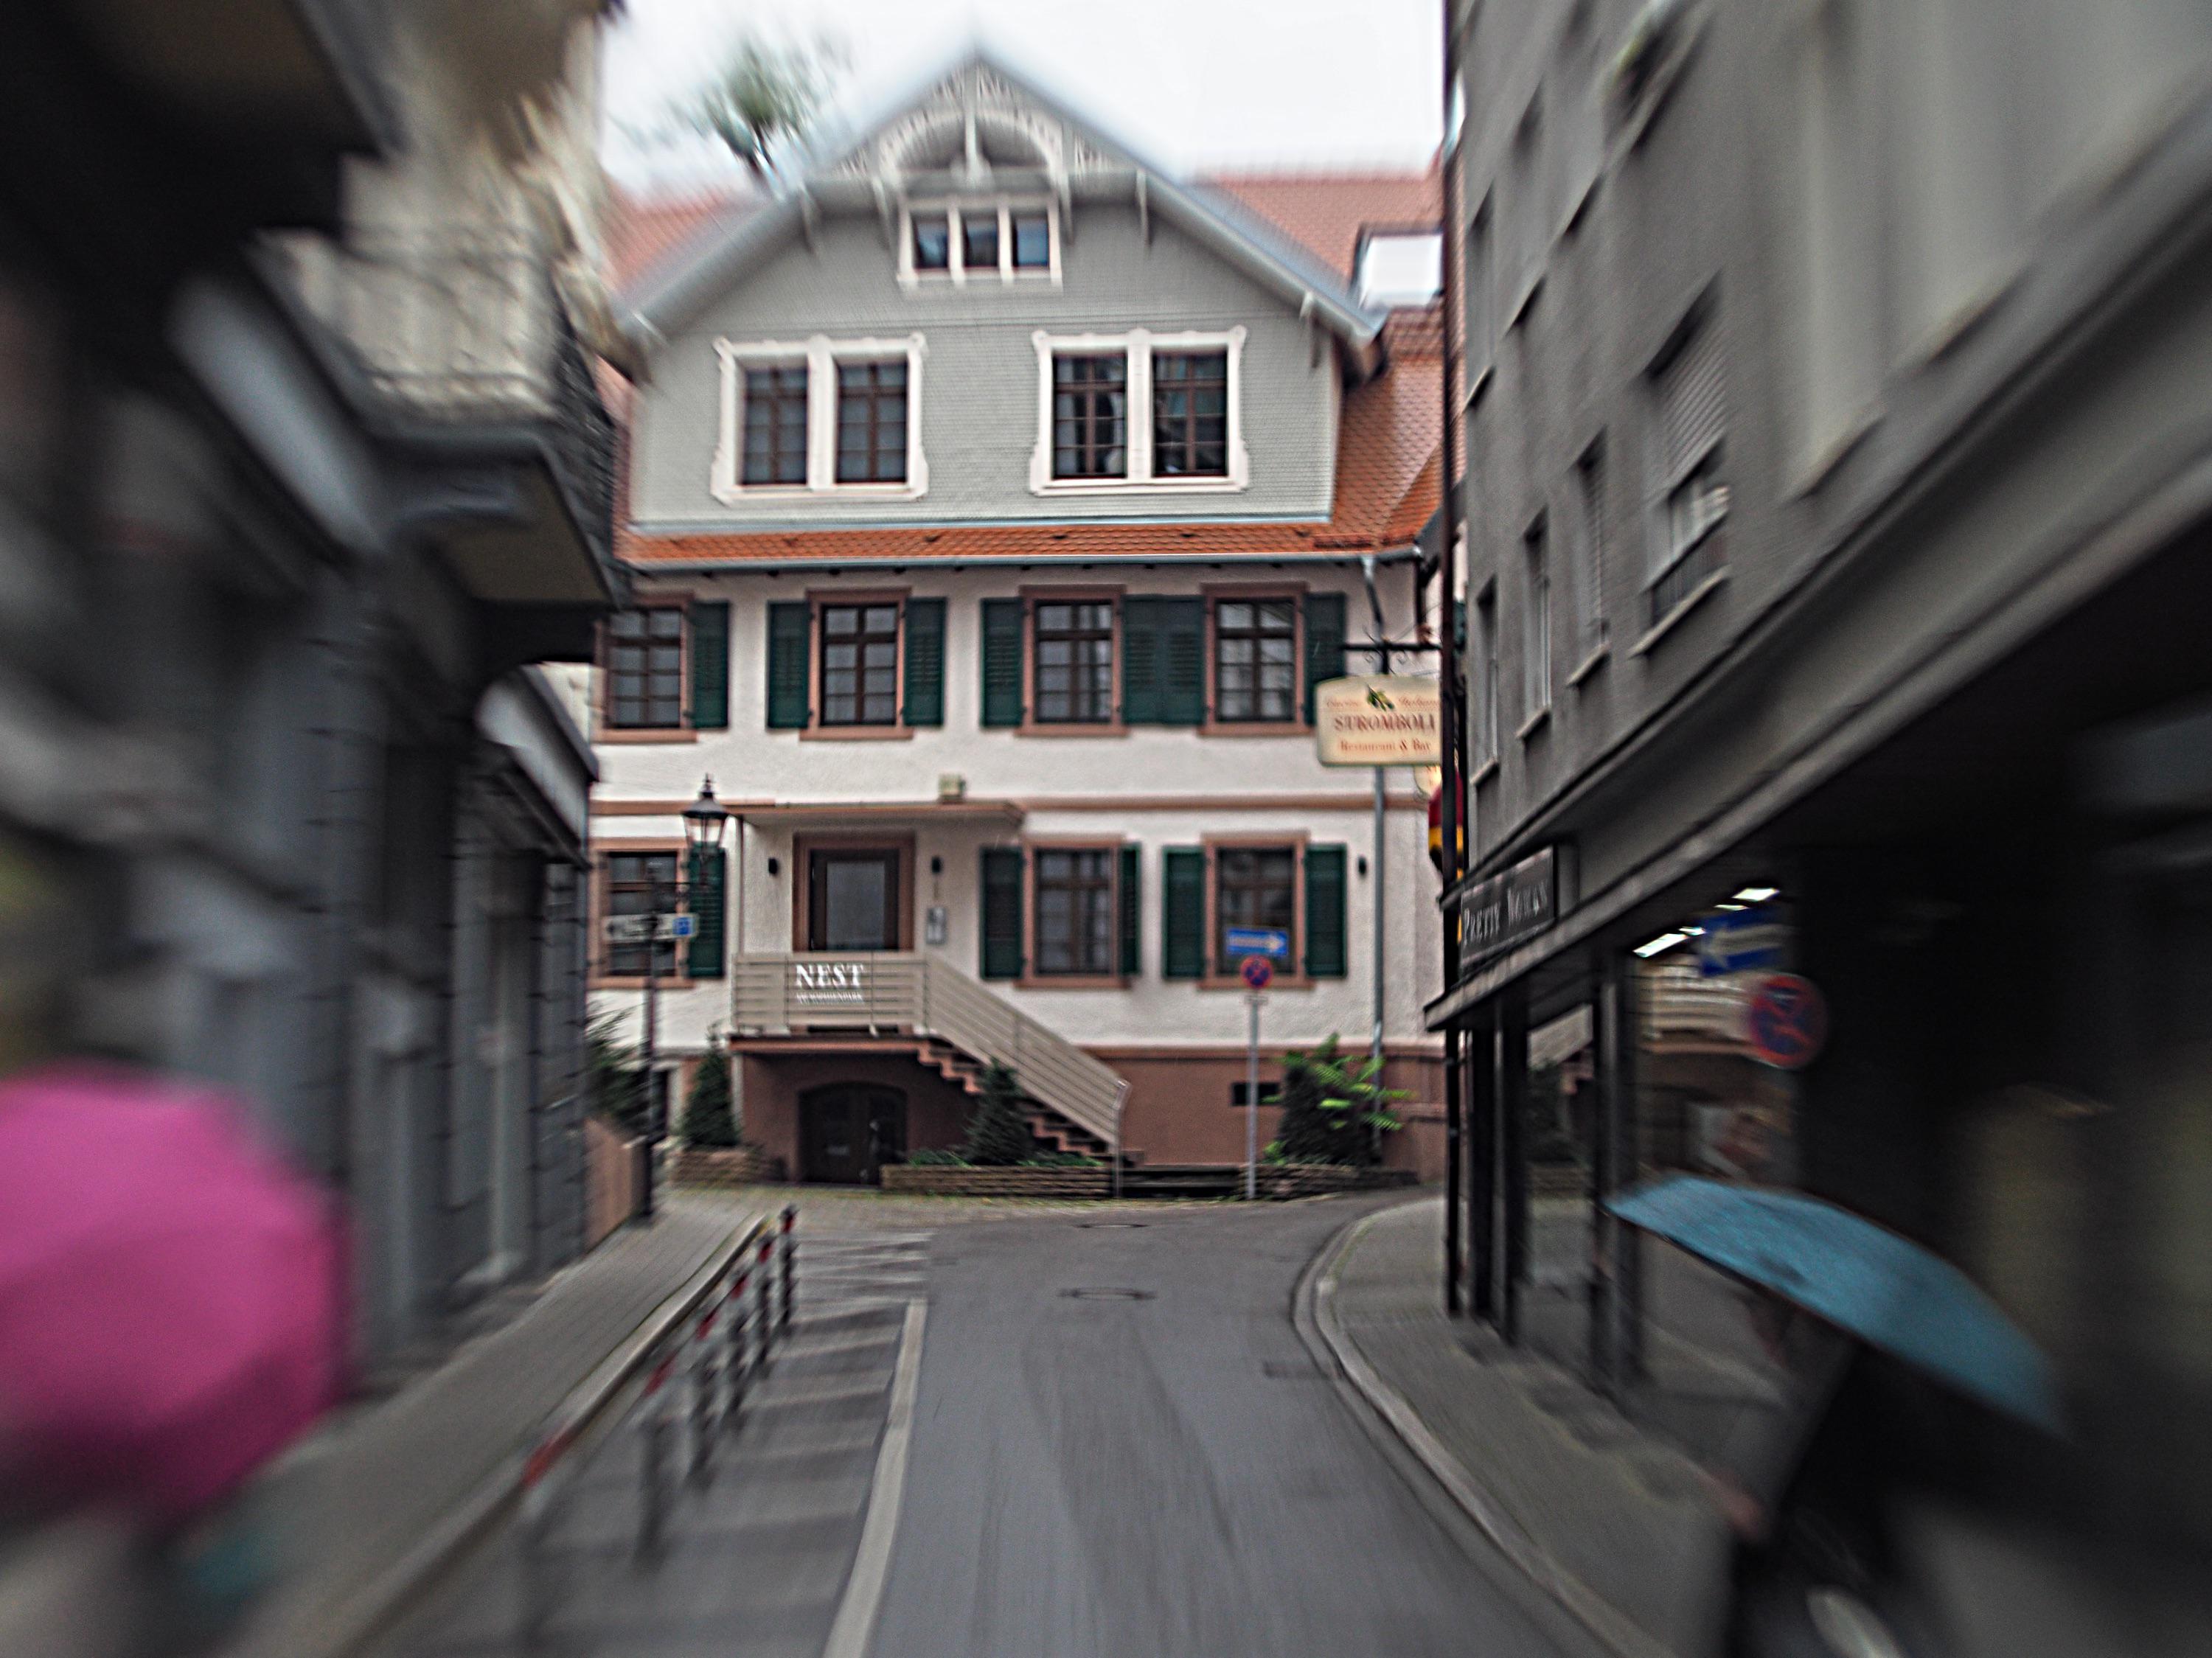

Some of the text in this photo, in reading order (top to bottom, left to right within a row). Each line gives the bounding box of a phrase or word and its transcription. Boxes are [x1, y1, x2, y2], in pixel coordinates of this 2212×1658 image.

[1334, 714, 1435, 733] STROMBOLI
[1340, 738, 1431, 752] Restaurant & Bar
[796, 964, 865, 989] NEST
